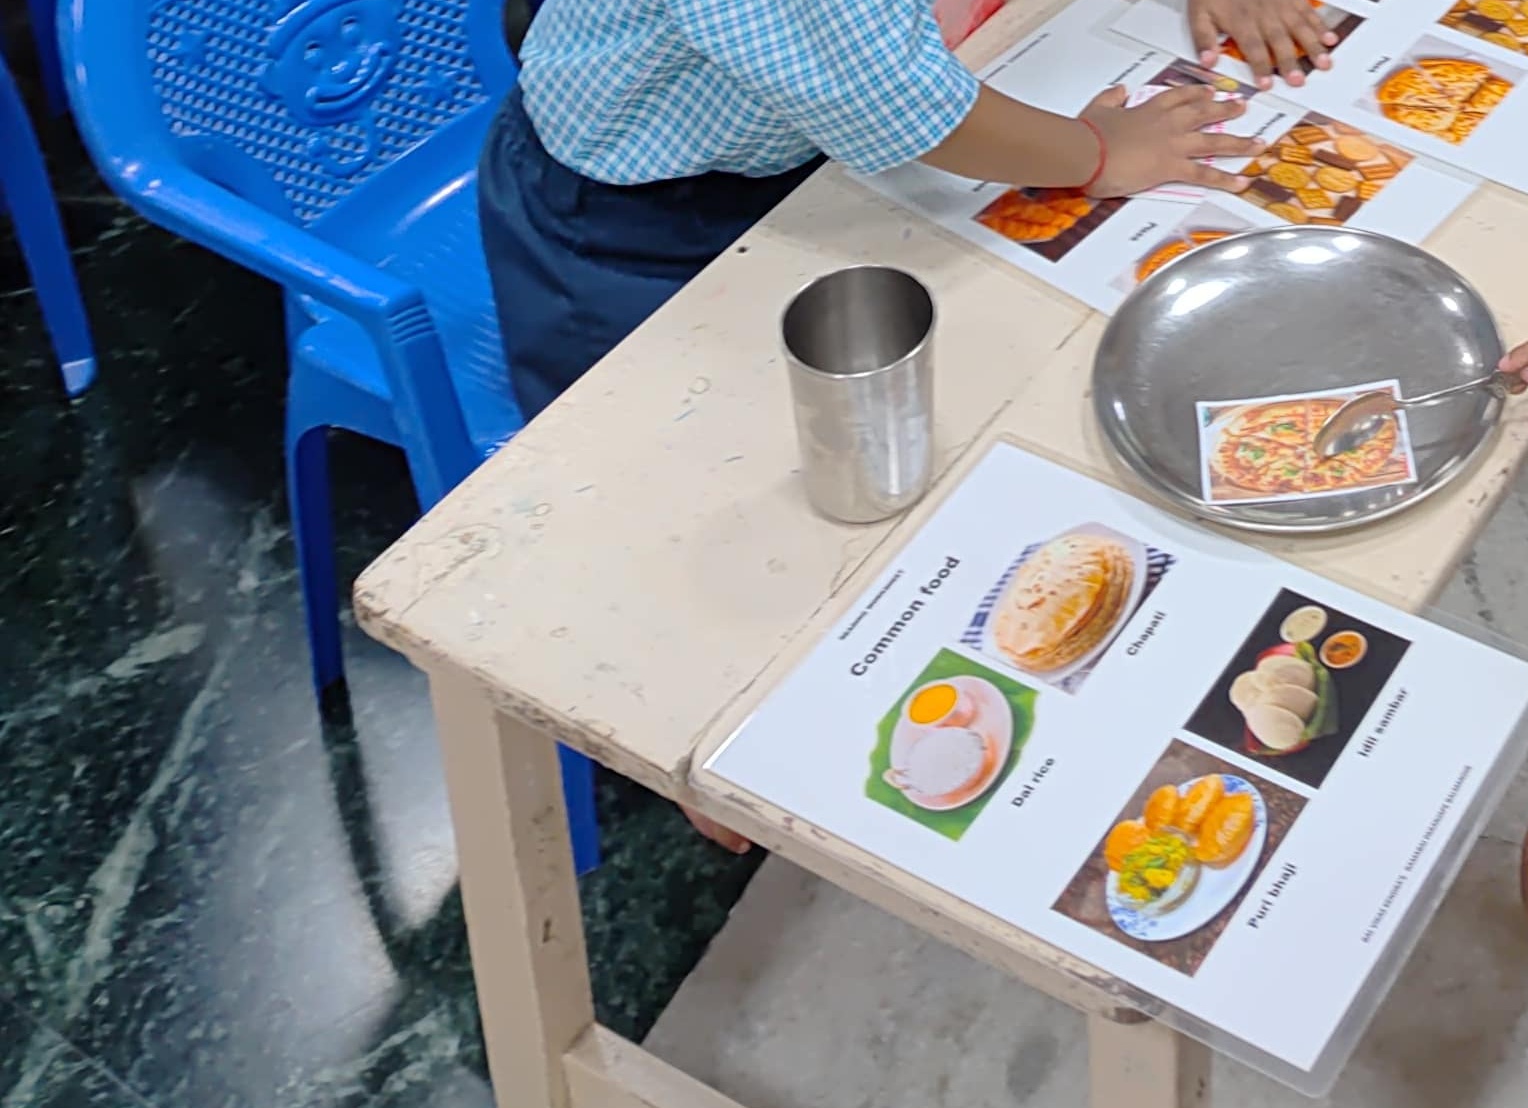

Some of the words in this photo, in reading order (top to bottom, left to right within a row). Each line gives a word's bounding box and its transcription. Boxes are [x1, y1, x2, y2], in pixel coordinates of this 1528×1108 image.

[850, 600, 925, 677] Common
[920, 555, 961, 596] food
[1126, 611, 1167, 657] Chapati
[1357, 736, 1378, 758] Idli
[1375, 688, 1408, 734] sambar
[1011, 785, 1035, 807] Dal
[1032, 758, 1055, 783] rice
[1247, 898, 1273, 929] Puri
[1267, 863, 1297, 898] bhaji
